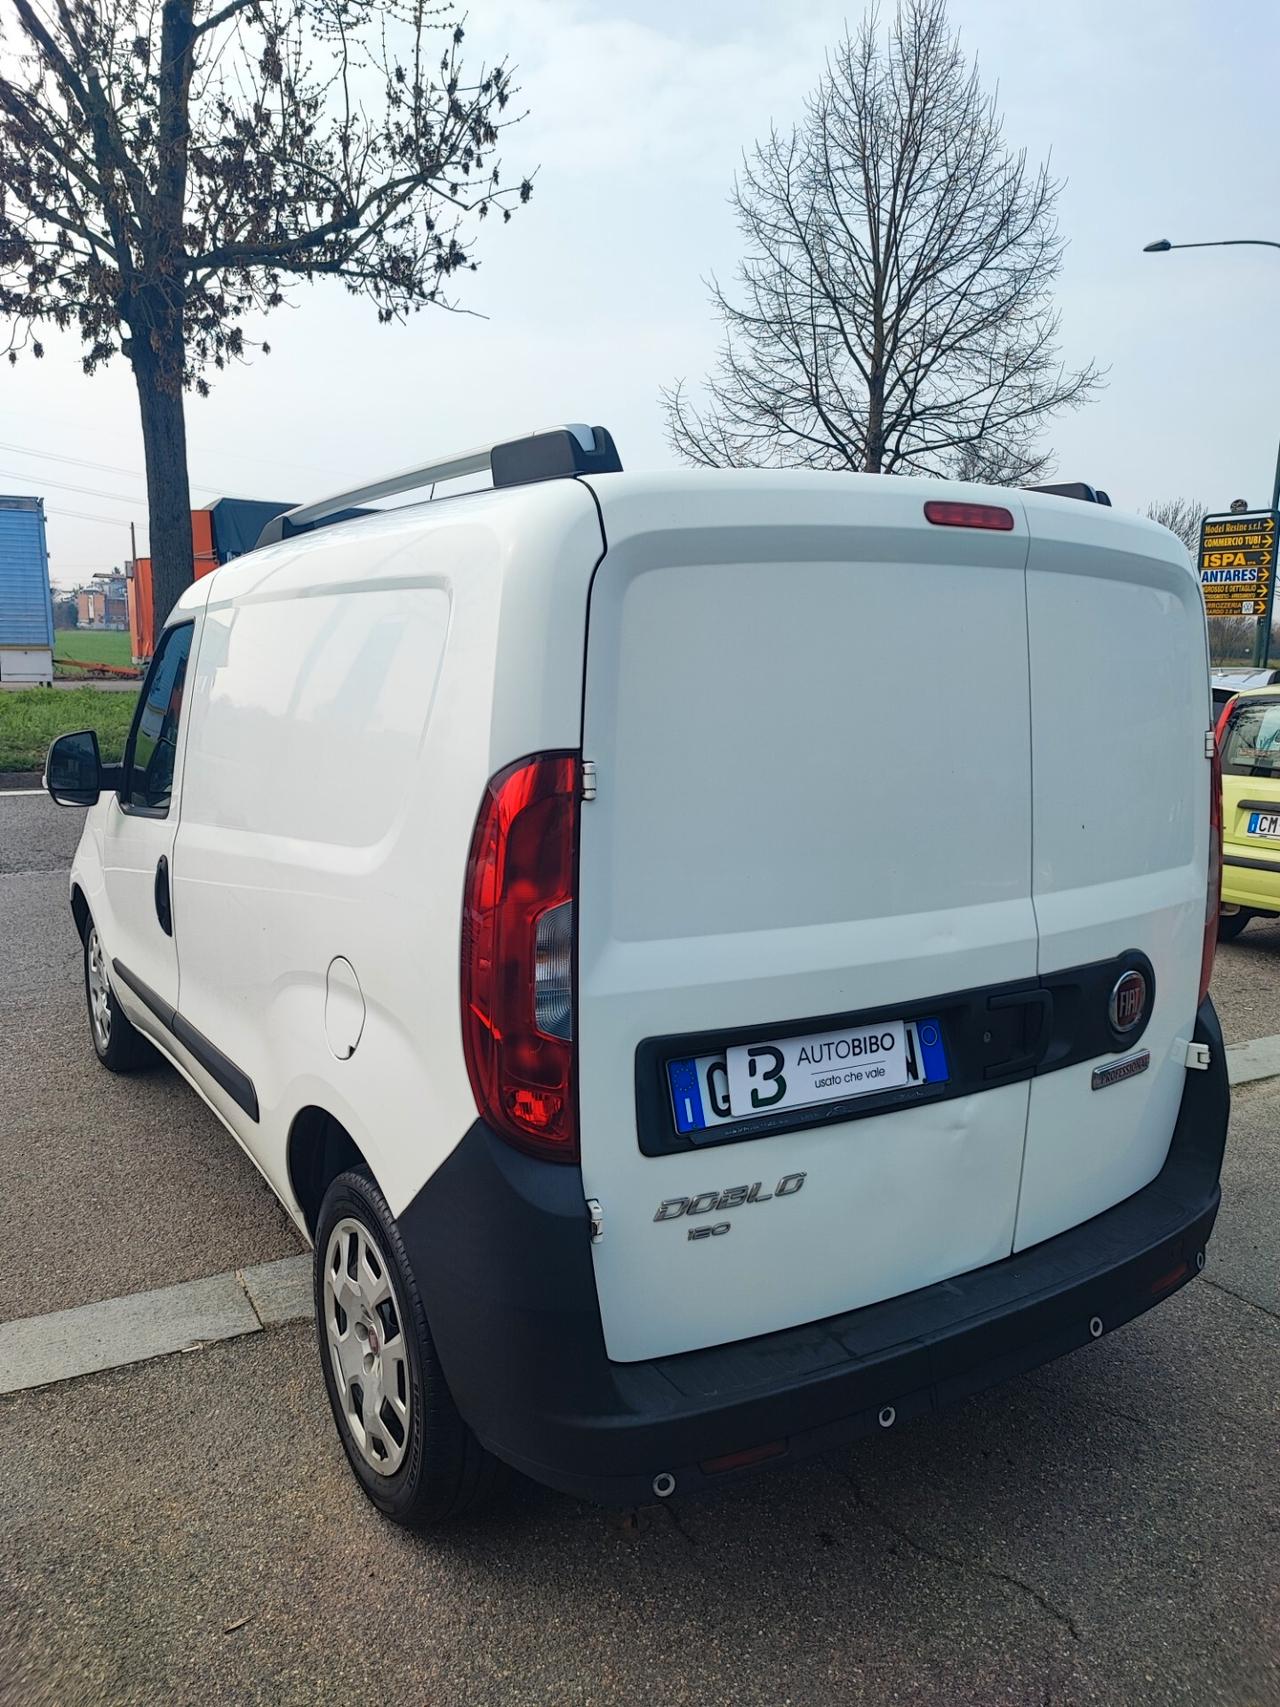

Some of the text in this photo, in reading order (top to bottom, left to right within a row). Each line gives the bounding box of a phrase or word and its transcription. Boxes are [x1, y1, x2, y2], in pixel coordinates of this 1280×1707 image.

[1204, 535, 1261, 548] COMMERCIO TUBI
[1203, 553, 1246, 567] ISPA
[1201, 569, 1257, 583] ANTARES
[1259, 816, 1279, 833] CM
[1119, 988, 1141, 1018] FIAT
[797, 1032, 895, 1067] AUTOBIBO
[814, 1066, 886, 1089] usato che vale
